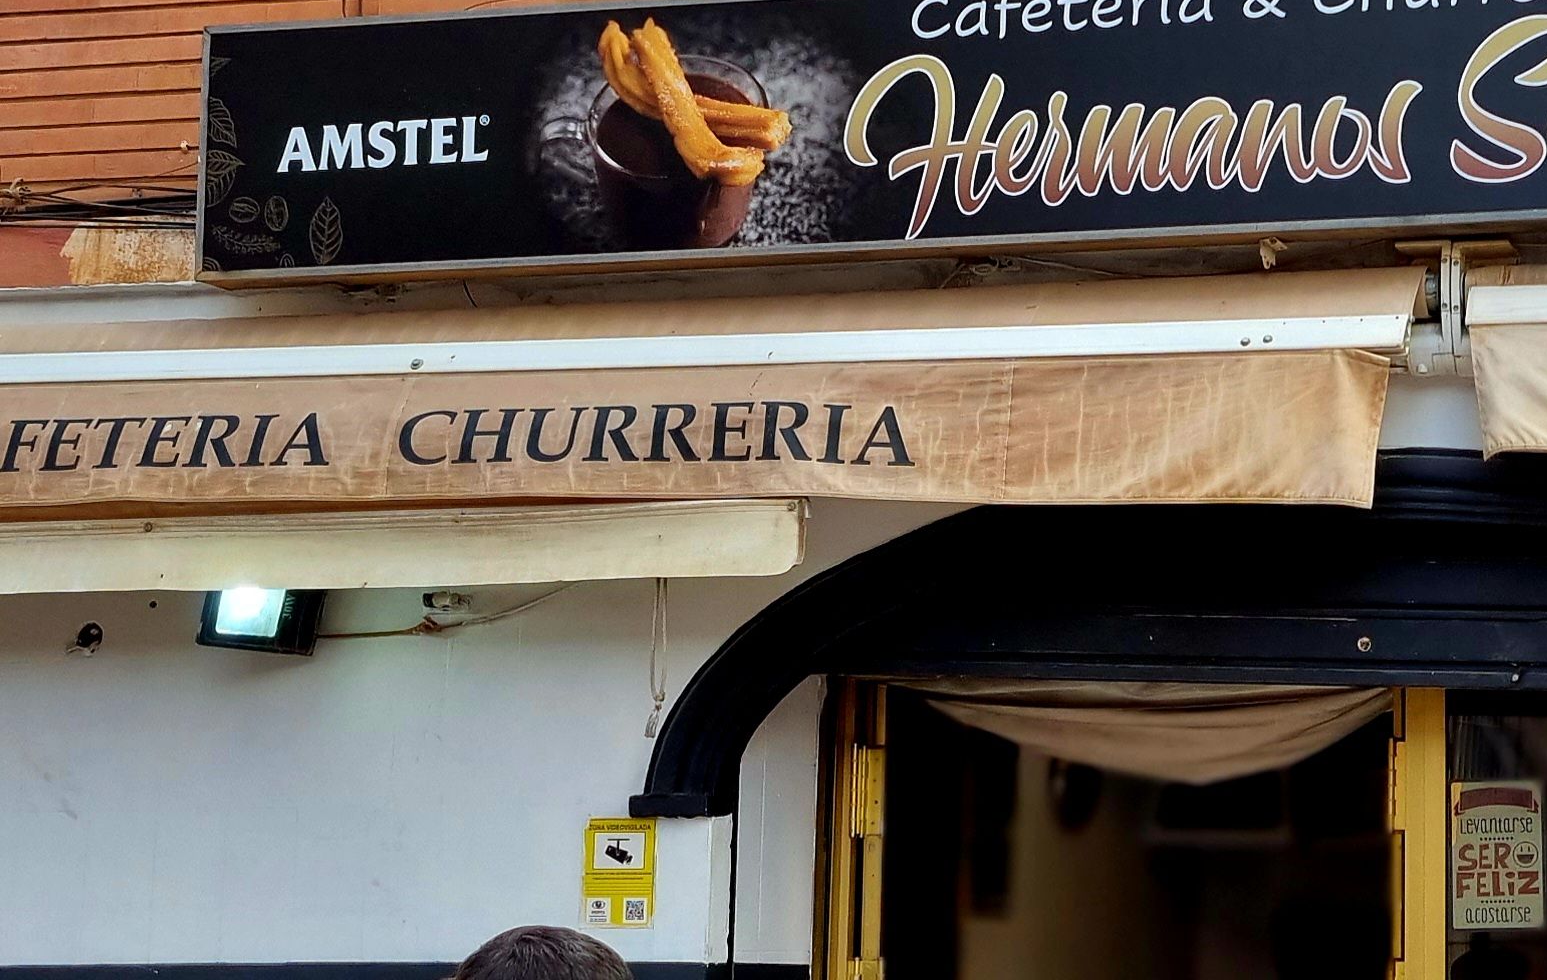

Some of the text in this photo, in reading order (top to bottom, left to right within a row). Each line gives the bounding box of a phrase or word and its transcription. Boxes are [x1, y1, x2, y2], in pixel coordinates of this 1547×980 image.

[842, 53, 1424, 240] Hermanos
[0, 399, 916, 473] FETERIA CHURRERIA
[1459, 816, 1533, 835] Levantarse
[1458, 842, 1512, 872] SER
[1465, 906, 1531, 924] acostarse
